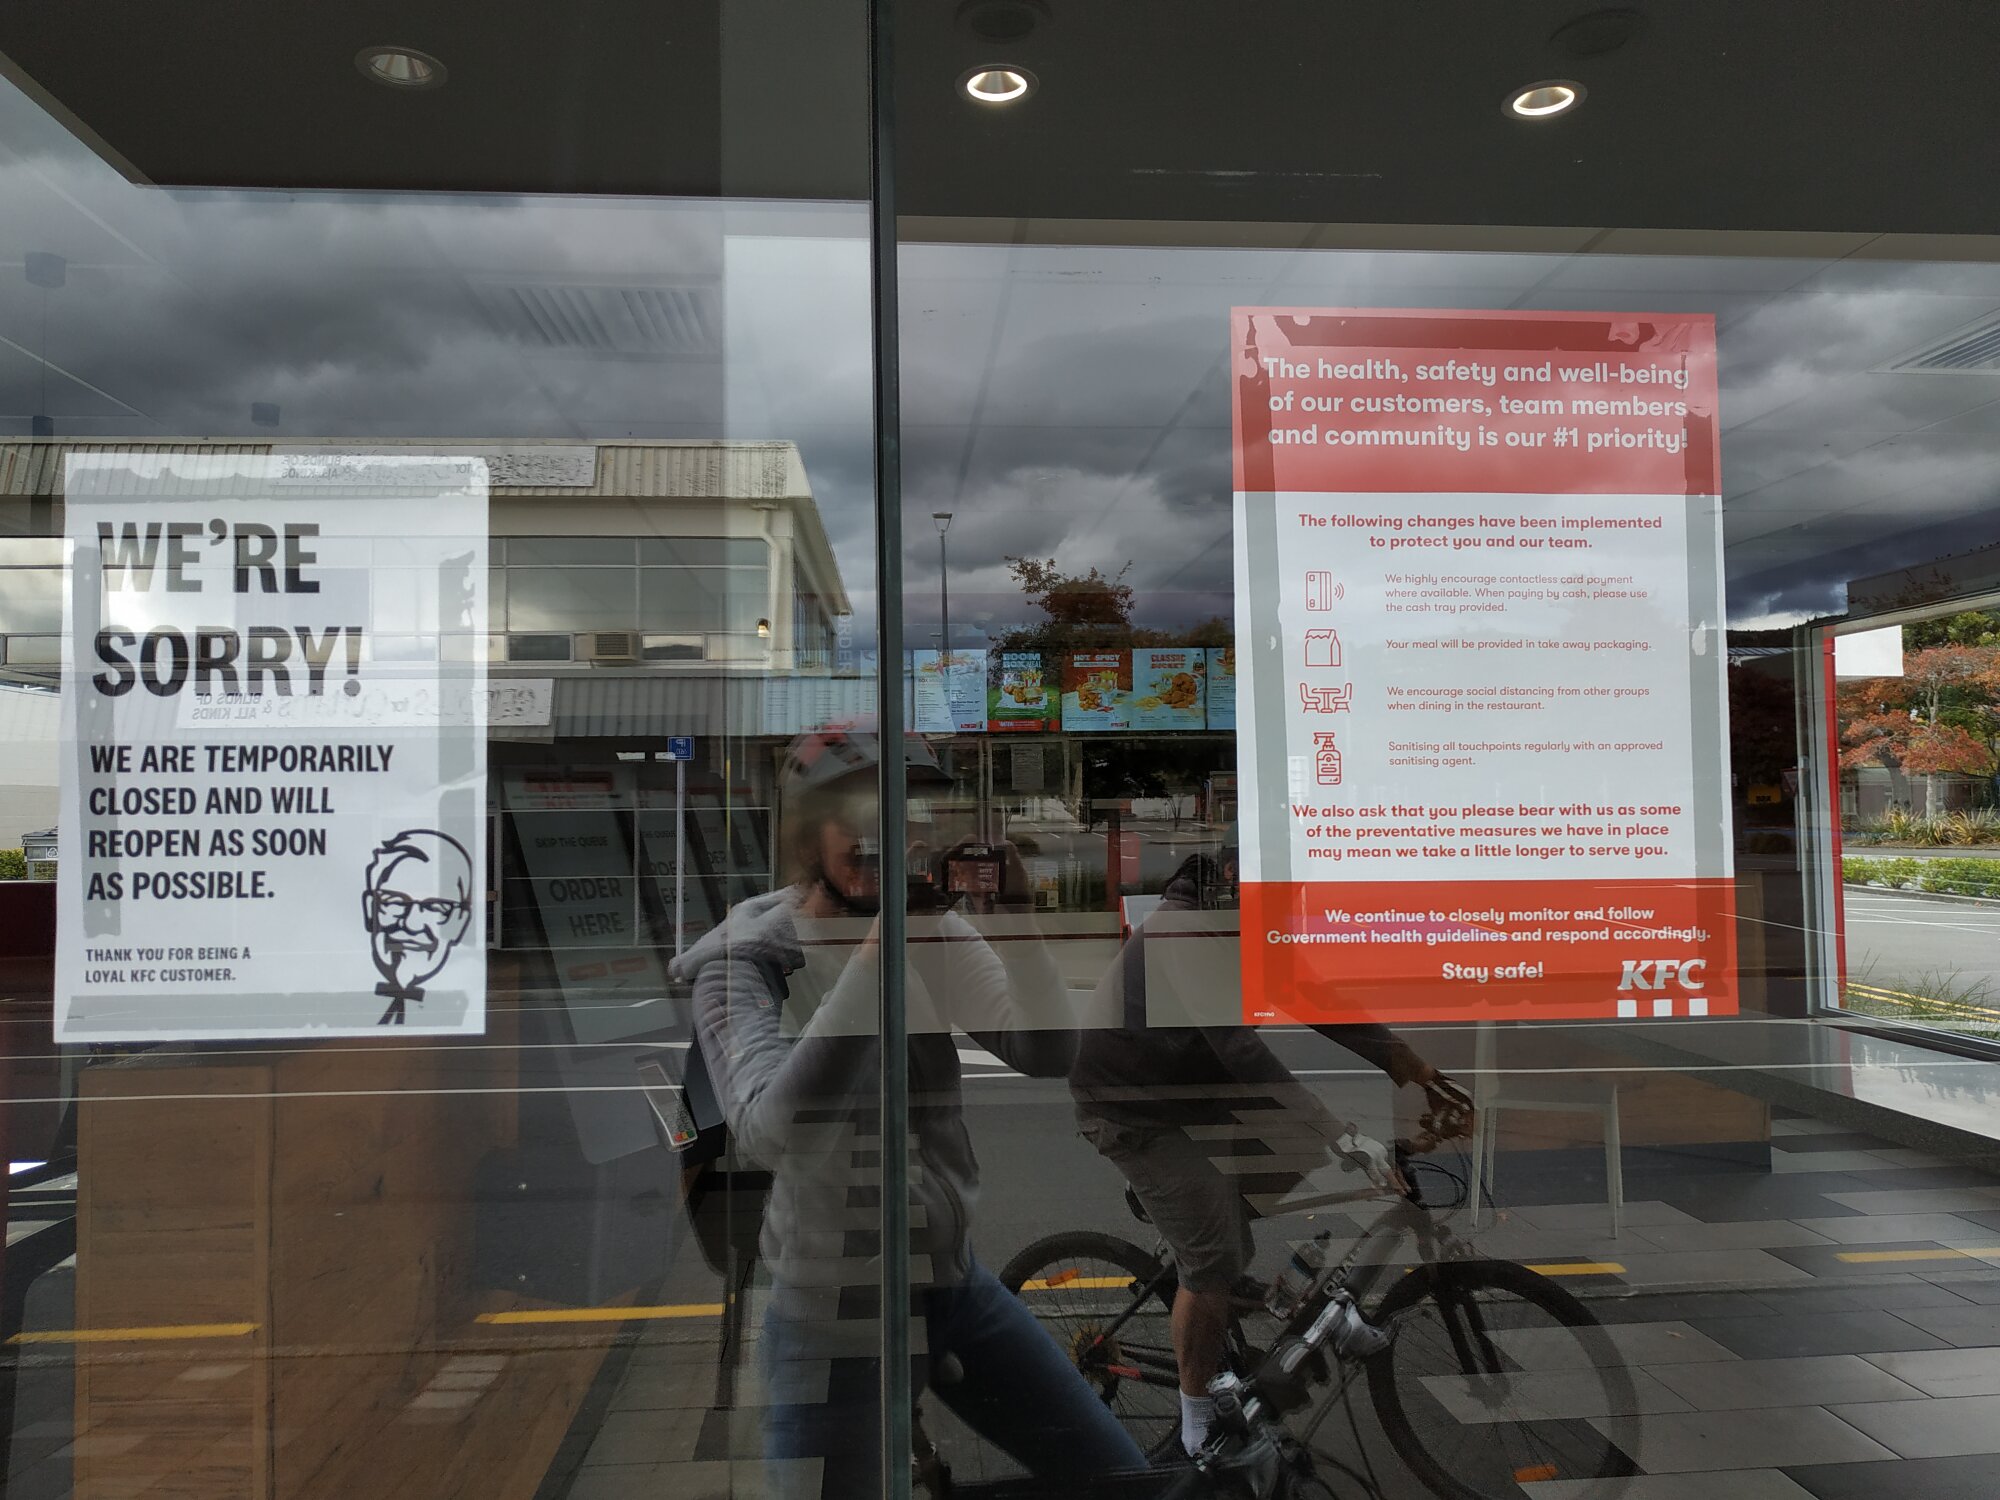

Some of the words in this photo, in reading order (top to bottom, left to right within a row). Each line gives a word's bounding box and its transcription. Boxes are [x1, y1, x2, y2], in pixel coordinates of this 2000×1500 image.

[1262, 356, 1310, 378] The
[1318, 357, 1408, 383] health,
[1415, 359, 1496, 386] safety
[1503, 360, 1551, 382] and
[1558, 362, 1688, 389] well-being
[1269, 391, 1294, 411] of
[1300, 396, 1343, 412] our
[1350, 393, 1491, 417] customers,
[1499, 395, 1563, 415] team
[1571, 395, 1686, 416] members
[1268, 423, 1317, 444] and
[1324, 424, 1470, 451] community
[1478, 425, 1498, 446] is
[1505, 431, 1546, 447] our
[1552, 426, 1578, 447] #1
[1587, 426, 1689, 453] priority!
[1298, 513, 1326, 527] The
[1330, 514, 1402, 530] following
[1407, 514, 1474, 530] changes
[1479, 514, 1515, 527] have
[1519, 515, 1557, 528] been
[1561, 515, 1662, 531] implemented
[1369, 535, 1385, 547] to
[1390, 535, 1448, 550] protect
[1452, 537, 1481, 550] you
[1485, 534, 1514, 547] and
[1519, 538, 1544, 547] our
[1548, 536, 1592, 548] team.
[1384, 573, 1402, 583] We
[1404, 573, 1437, 585] highly
[1440, 575, 1497, 585] encourage
[1499, 574, 1557, 583] contactless
[1559, 574, 1584, 584] card
[1586, 575, 1633, 586] payment
[1385, 588, 1417, 597] where
[1420, 587, 1471, 598] available.
[1474, 587, 1504, 597] When
[1507, 588, 1543, 600] paying
[1546, 588, 1559, 600] by
[1562, 588, 1590, 598] cash,
[1592, 588, 1627, 600] please
[1629, 590, 1647, 598] use
[1385, 602, 1402, 612] the
[1405, 602, 1431, 612] cash
[1434, 603, 1456, 614] tray
[1459, 602, 1507, 614] provided.
[1385, 639, 1409, 649] Your
[1412, 639, 1438, 648] meal
[1440, 638, 1458, 648] will
[1461, 639, 1474, 648] be
[1477, 639, 1522, 650] provided
[1525, 639, 1535, 648] in
[1537, 639, 1559, 648] take
[1562, 641, 1590, 651] away
[1593, 639, 1651, 651] packaging.
[92, 625, 362, 697] SORRY!
[1386, 686, 1404, 696] We
[1406, 688, 1463, 698] encourage
[1466, 686, 1496, 696] social
[1499, 686, 1554, 698] distancing
[1556, 685, 1580, 695] from
[1583, 686, 1610, 695] other
[1613, 688, 1649, 698] groups
[1387, 700, 1415, 710] when
[1418, 700, 1451, 712] dining
[1454, 700, 1463, 710] in
[1466, 700, 1484, 710] the
[1486, 701, 1544, 710] restaurant.
[1388, 740, 1440, 754] Sanitising
[1442, 741, 1455, 751] all
[1458, 741, 1521, 753] touchpoints
[1524, 740, 1570, 753] regularly
[1572, 740, 1594, 750] with
[1613, 740, 1663, 752] approved
[90, 745, 131, 772] WE
[140, 745, 195, 772] ARE
[204, 744, 393, 772] TEMPORARILY
[1389, 755, 1439, 768] sanitising
[1441, 756, 1475, 767] agent.
[89, 787, 196, 815] CLOSED
[205, 787, 261, 814] AND
[271, 786, 334, 814] WILL
[1292, 804, 1317, 817] We
[1321, 804, 1354, 817] also
[1358, 804, 1386, 817] ask
[1390, 804, 1424, 817] that
[1429, 807, 1457, 820] you
[1462, 803, 1514, 819] please
[1519, 803, 1555, 816] bear
[1558, 803, 1591, 815] with
[1596, 806, 1613, 815] us
[1617, 806, 1635, 815] as
[1639, 805, 1681, 815] some
[1306, 824, 1321, 837] of
[1325, 824, 1351, 837] the
[1356, 824, 1455, 840] preventative
[1459, 827, 1536, 837] measures
[1540, 826, 1562, 836] we
[1566, 823, 1603, 836] have
[1607, 822, 1621, 835] in
[1625, 822, 1669, 838] place
[89, 829, 199, 857] REOPEN
[208, 828, 244, 856] AS
[252, 828, 325, 856] SOON
[1308, 848, 1341, 861] may
[1346, 848, 1391, 857] mean
[1395, 848, 1418, 857] we
[1422, 844, 1456, 857] take
[1460, 847, 1469, 857] a
[1474, 844, 1511, 857] little
[1515, 843, 1565, 860] longer
[1568, 844, 1584, 856] to
[1588, 846, 1630, 856] serve
[1634, 846, 1667, 859] you.
[87, 872, 123, 900] AS
[132, 870, 274, 900] POSSIBLE.
[549, 878, 623, 902] ORDER
[1325, 909, 1350, 923] We
[1354, 908, 1425, 923] continue
[1428, 909, 1446, 922] to
[1449, 908, 1505, 924] closely
[1508, 908, 1569, 922] monitor
[1574, 907, 1604, 920] and
[1607, 906, 1655, 920] follow
[568, 911, 625, 938] HERE
[1266, 929, 1367, 944] Government
[1370, 929, 1422, 943] health
[1426, 928, 1508, 946] guidelines
[1510, 927, 1541, 941] and
[1545, 926, 1609, 944] respond
[1613, 924, 1710, 943] accordingly.
[85, 948, 132, 962] THANK
[136, 948, 164, 961] YOU
[168, 947, 193, 960] FOR
[198, 947, 237, 960] BEING
[242, 946, 250, 959] A
[85, 969, 125, 983] LOYAL
[130, 969, 155, 982] KFC
[159, 967, 235, 982] CUSTOMER.
[1442, 961, 1488, 983] Stay
[1494, 961, 1543, 978] safe!
[1617, 959, 1707, 990] KFC
